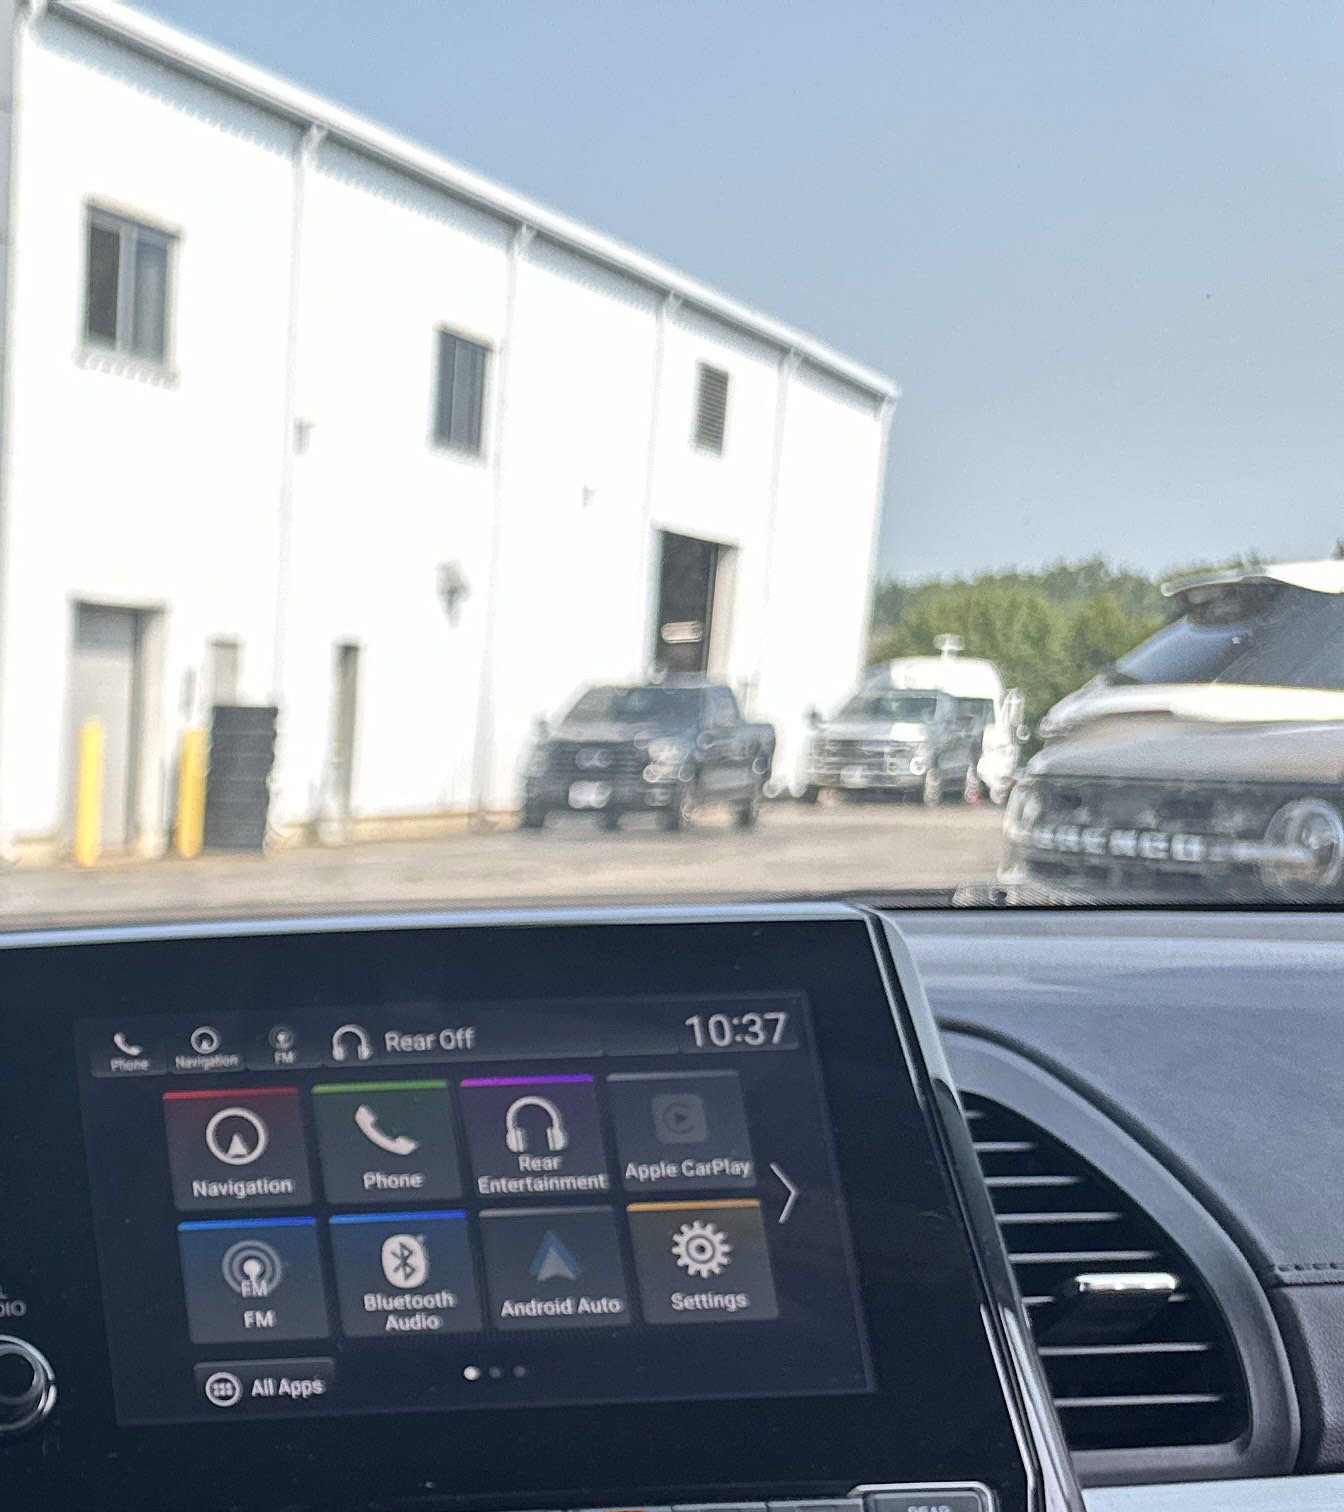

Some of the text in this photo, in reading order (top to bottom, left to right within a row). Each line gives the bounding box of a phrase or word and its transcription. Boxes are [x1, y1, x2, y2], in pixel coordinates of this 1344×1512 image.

[384, 1027, 476, 1053] Rear Off
[685, 1012, 788, 1049] 10:37
[110, 1057, 150, 1072] Phone
[175, 1054, 239, 1070] Navigation
[274, 1051, 296, 1065] FM
[518, 1155, 561, 1171] Rear
[625, 1157, 753, 1181] Apple CarPlay
[192, 1177, 293, 1198] Navigation
[363, 1171, 425, 1192] Phone
[478, 1173, 609, 1194] Entertainment
[363, 1291, 456, 1312] Bluetooth
[500, 1297, 623, 1318] Android Auto
[670, 1291, 750, 1312] Settings
[243, 1311, 276, 1328] FM
[385, 1312, 443, 1332] Audio
[251, 1377, 325, 1399] All Apps
